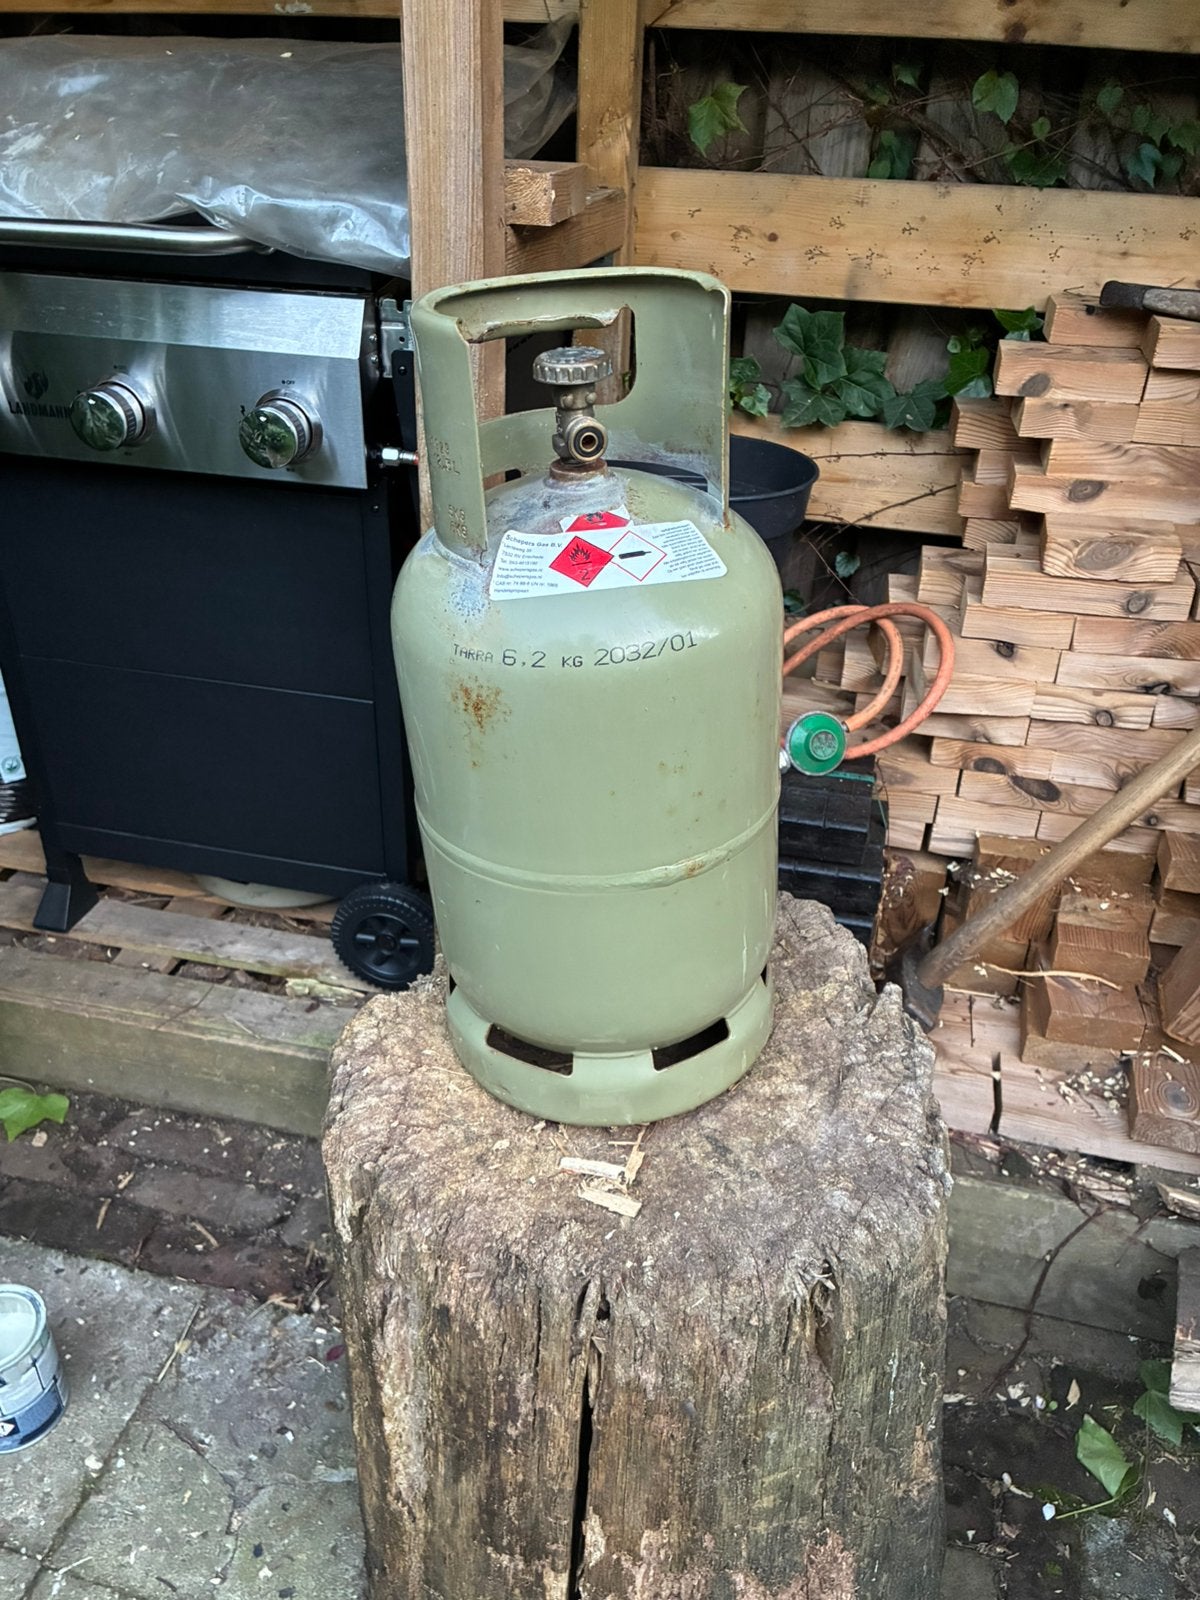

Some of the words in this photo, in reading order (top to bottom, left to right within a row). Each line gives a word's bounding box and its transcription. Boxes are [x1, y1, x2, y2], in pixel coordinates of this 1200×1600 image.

[505, 534, 535, 547] Schepers
[579, 568, 591, 581] 2
[453, 643, 494, 663] TARRA
[561, 655, 583, 668] KG
[594, 631, 698, 666] 2032/01
